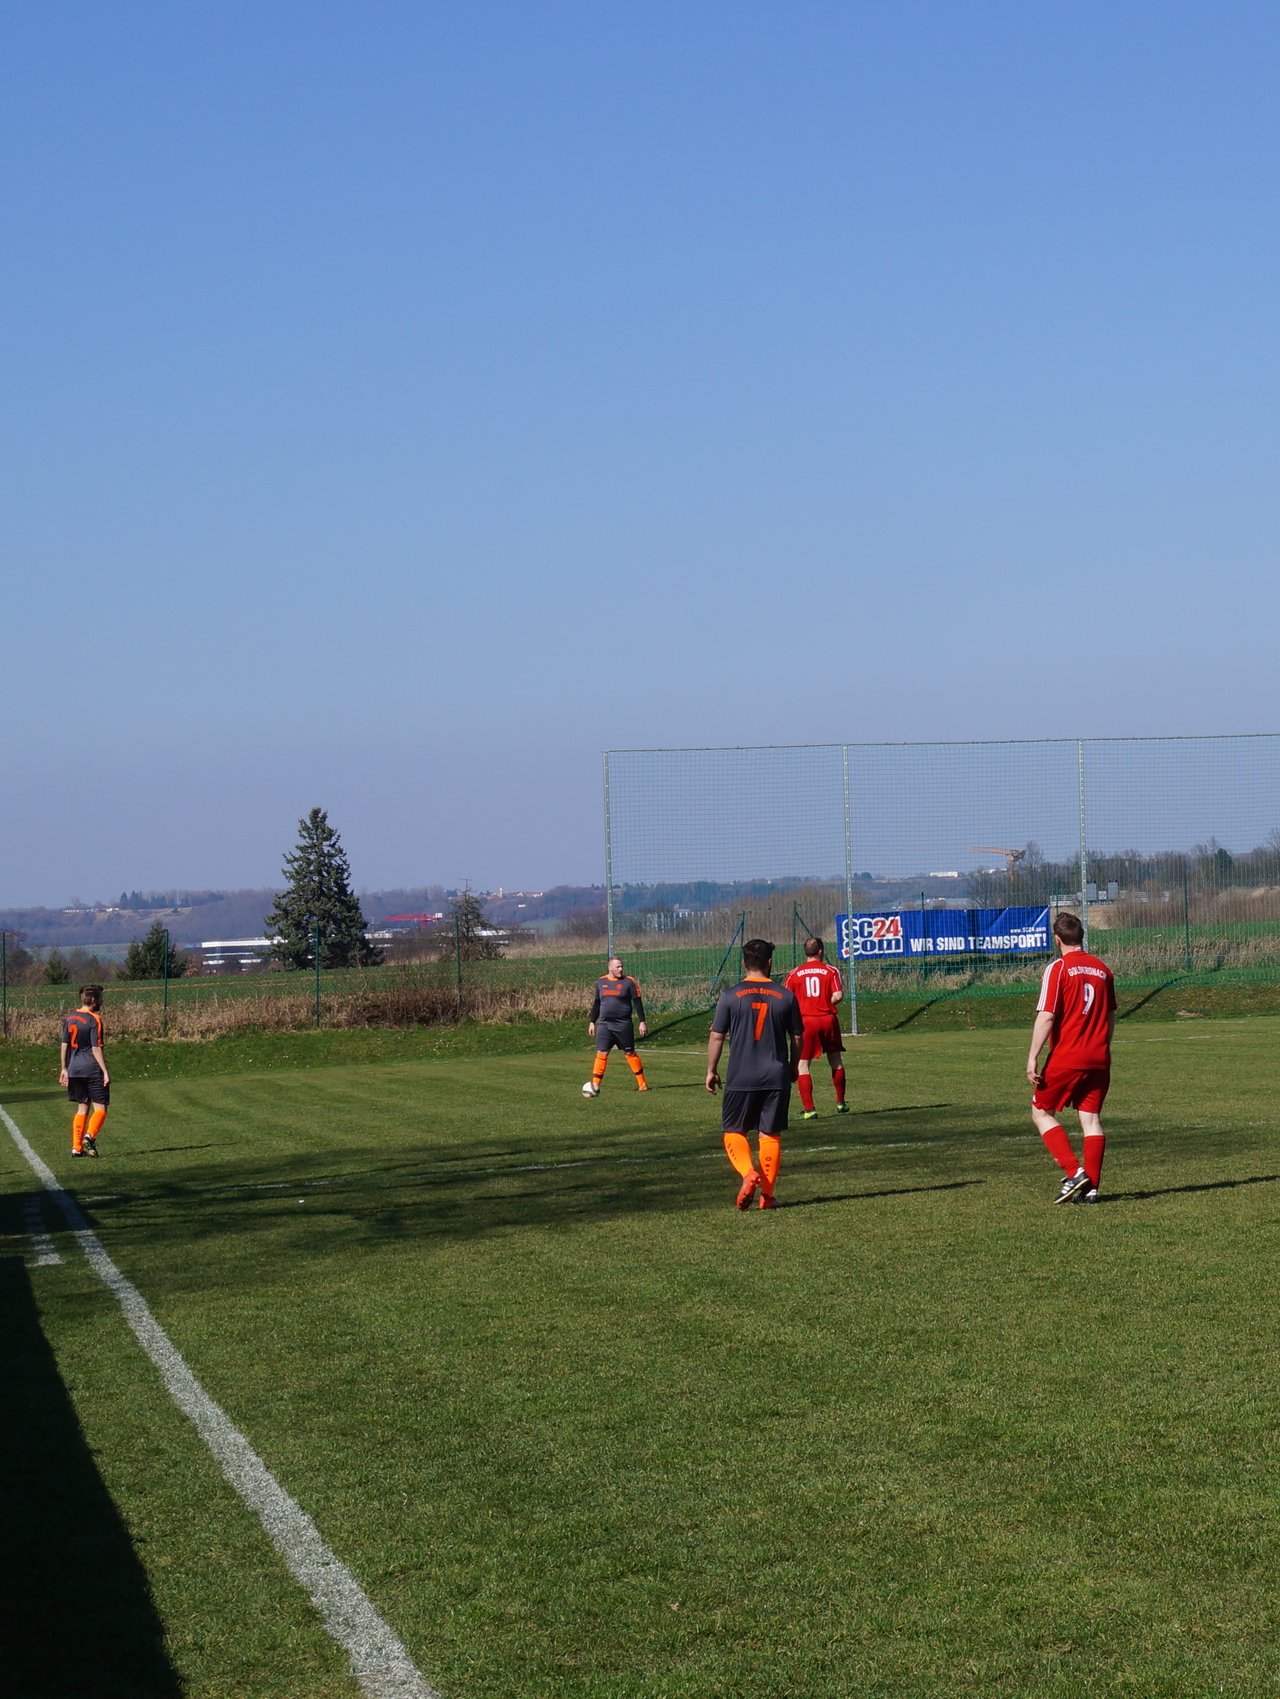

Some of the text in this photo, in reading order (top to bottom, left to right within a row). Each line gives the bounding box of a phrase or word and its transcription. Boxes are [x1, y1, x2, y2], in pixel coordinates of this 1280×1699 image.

[842, 916, 903, 939] SC24
[910, 933, 1047, 952] WIR SIND TEAMSPORT!
[805, 976, 820, 998] 10
[1082, 983, 1095, 1015] 9
[751, 1002, 768, 1041] 7
[68, 1024, 79, 1049] 2
